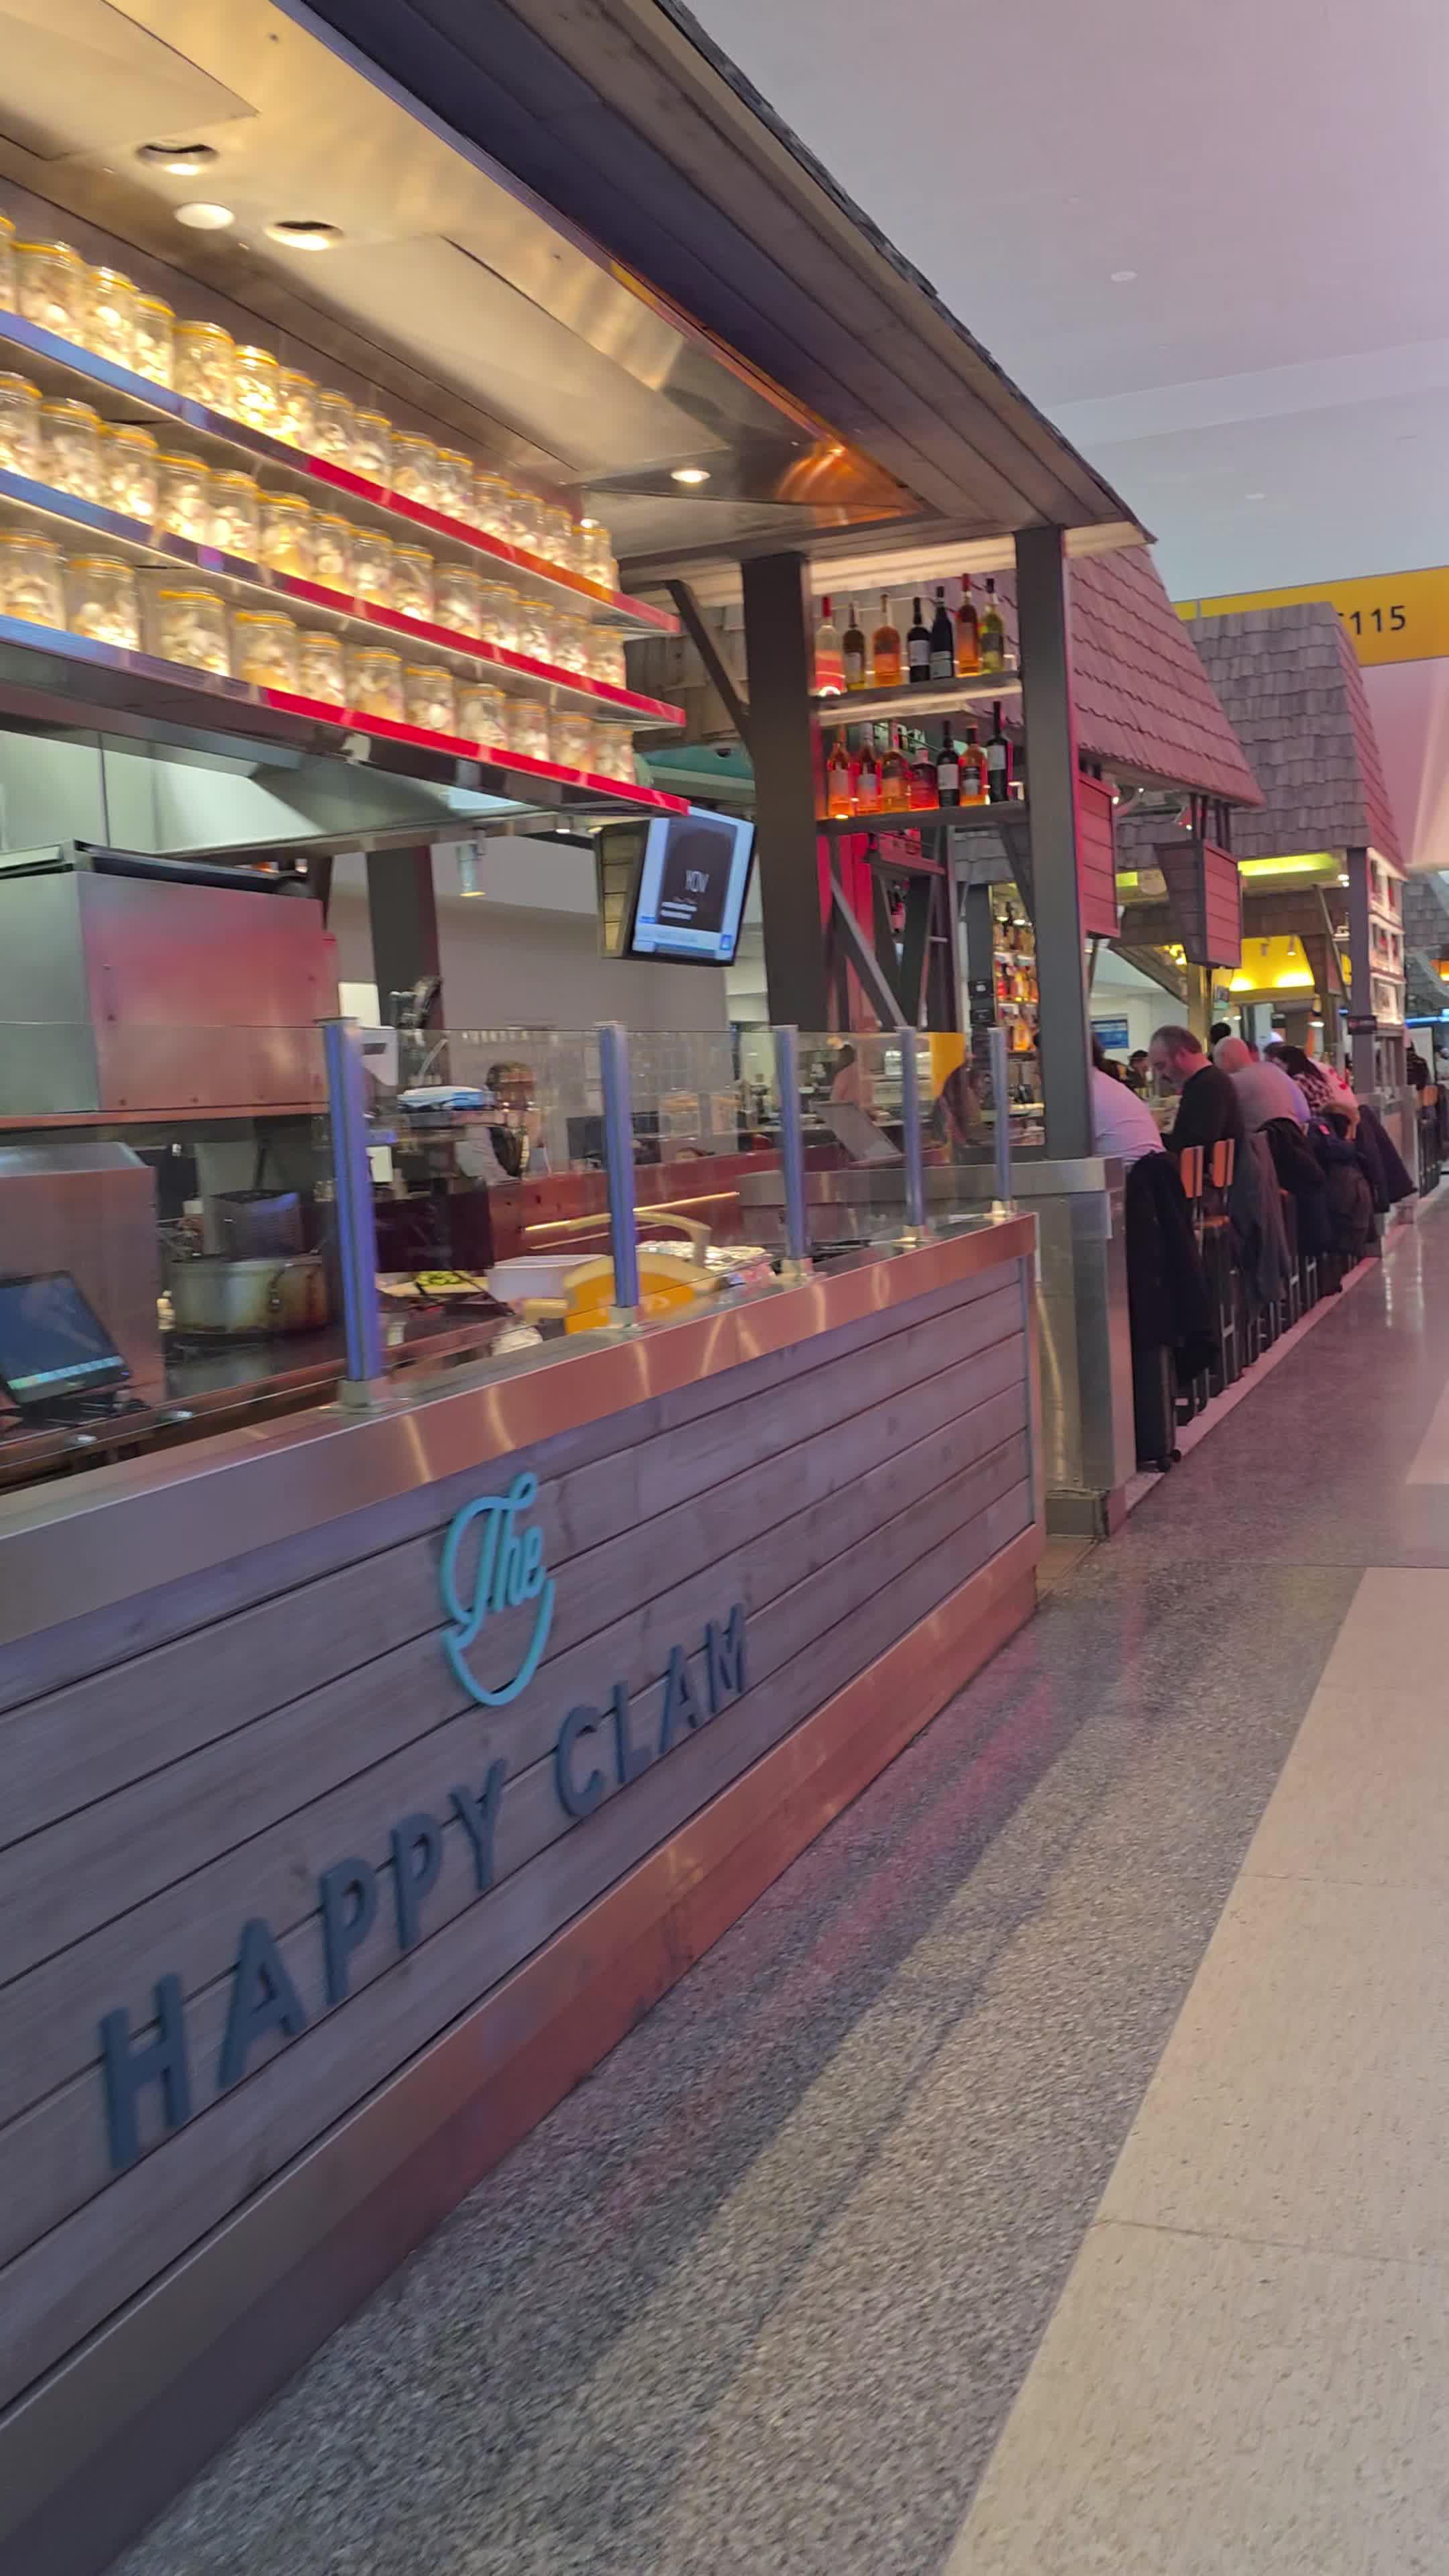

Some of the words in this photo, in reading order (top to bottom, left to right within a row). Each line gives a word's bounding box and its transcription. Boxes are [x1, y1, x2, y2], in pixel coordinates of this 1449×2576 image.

[1337, 605, 1407, 635] 115
[440, 1471, 556, 1707] The
[99, 1757, 507, 2171] HAPPY
[554, 1603, 748, 1817] CLAM
